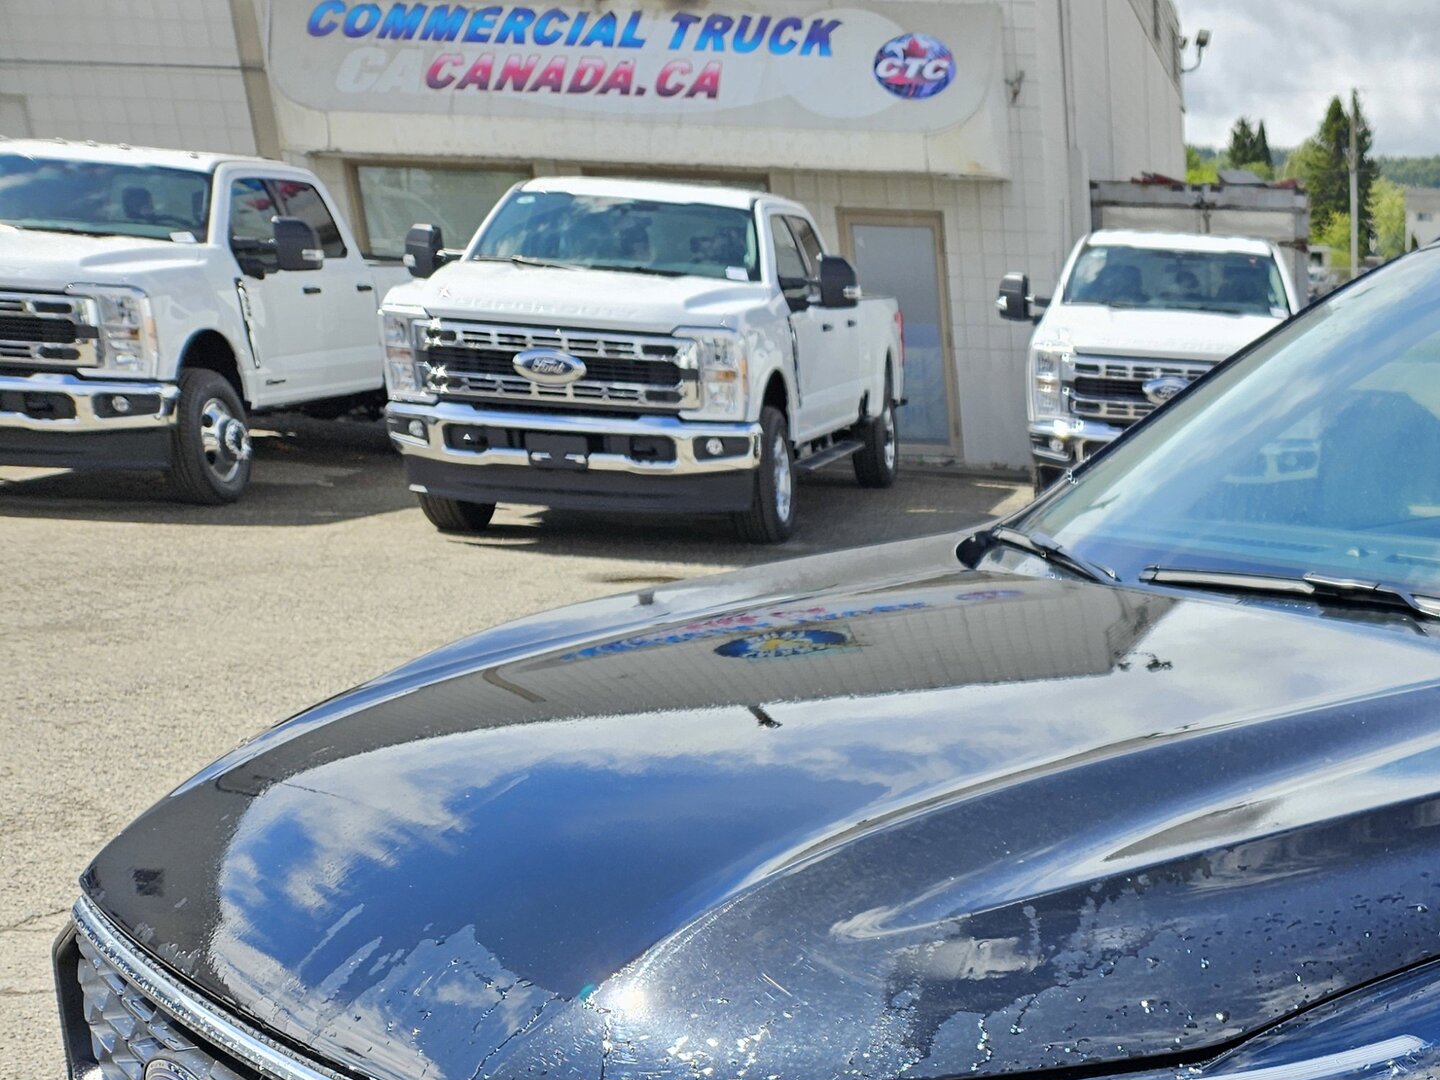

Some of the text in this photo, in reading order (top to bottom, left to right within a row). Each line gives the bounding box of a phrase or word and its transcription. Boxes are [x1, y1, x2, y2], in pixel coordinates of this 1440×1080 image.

[306, 0, 844, 57] COMMERCIAL TRUCK
[426, 52, 723, 99] CANADA.CA
[876, 57, 950, 80] CTC
[532, 358, 566, 373] Ford
